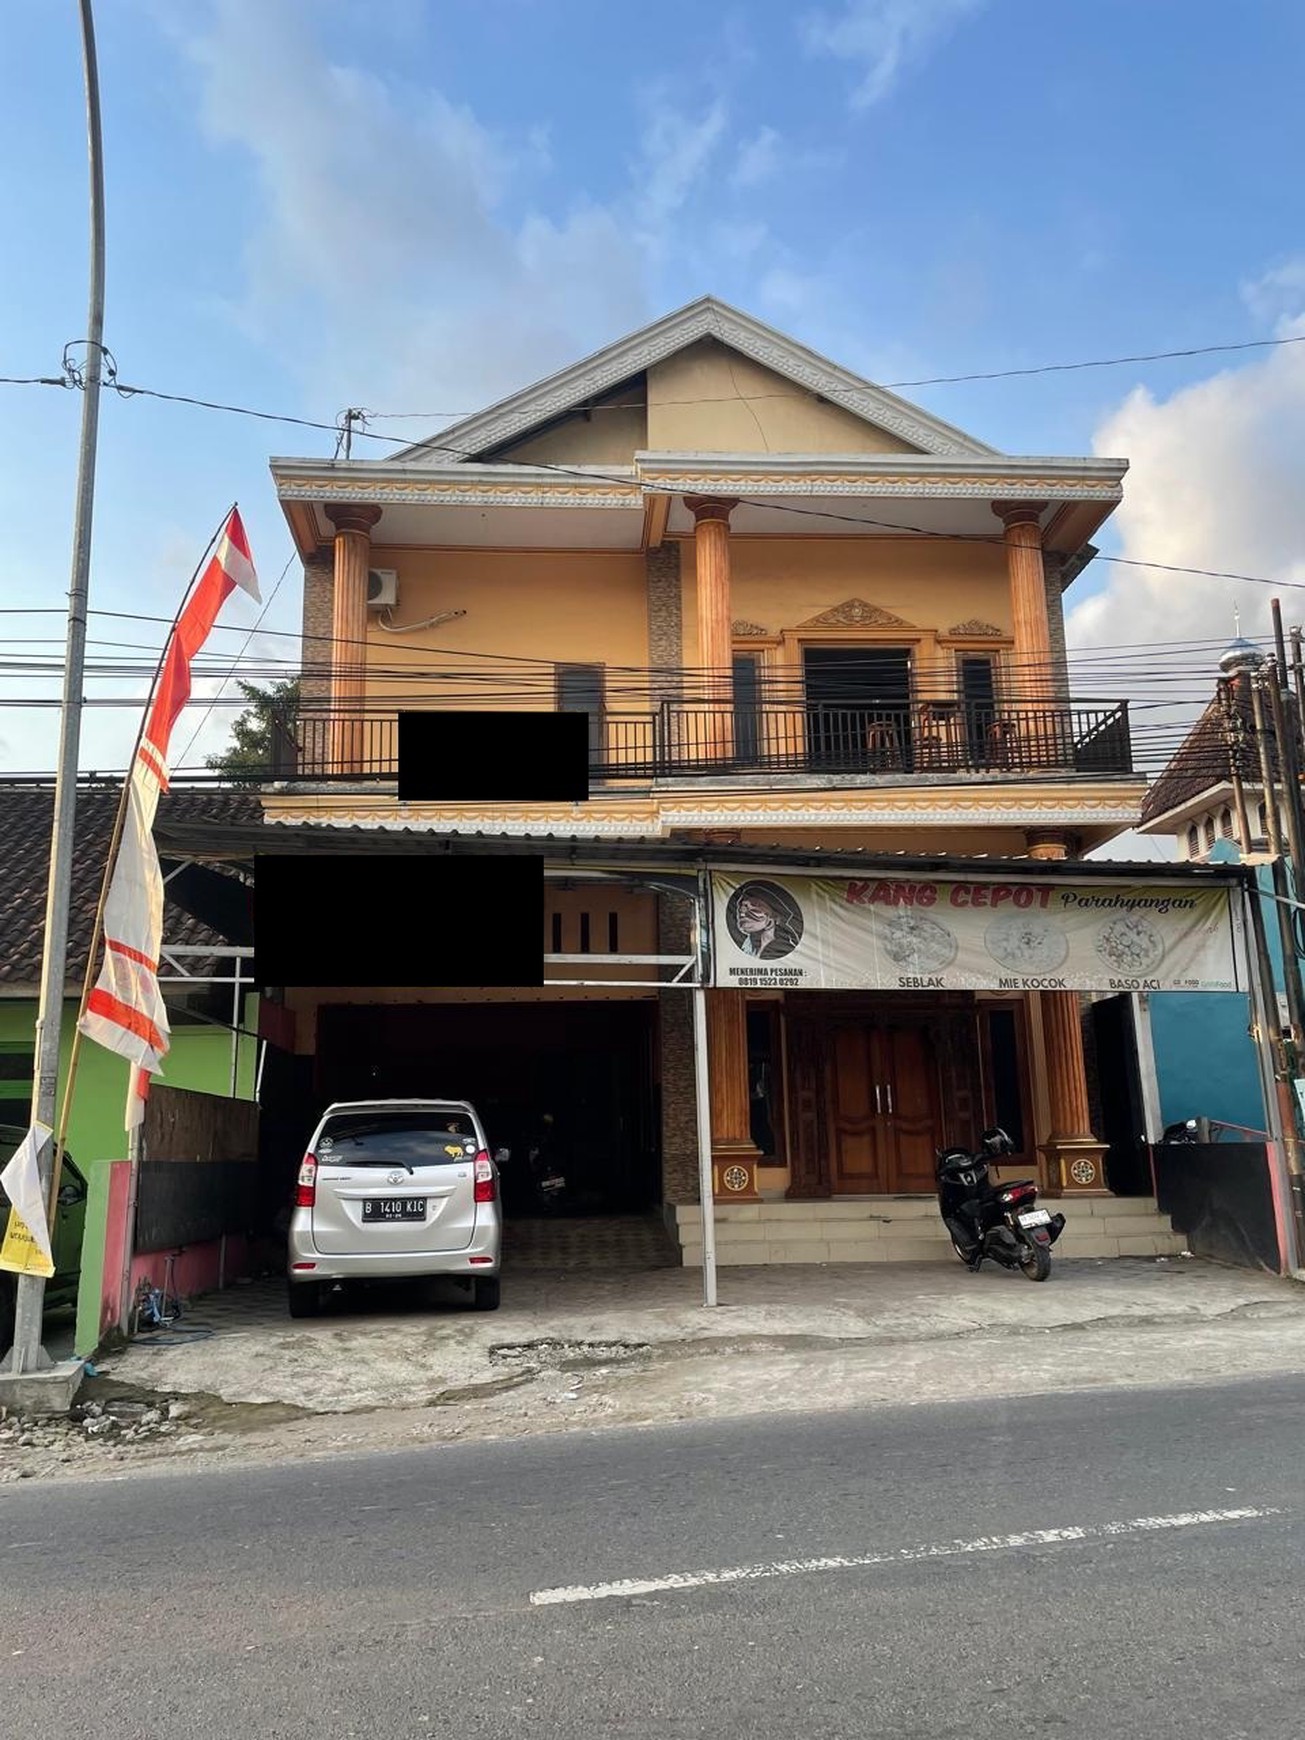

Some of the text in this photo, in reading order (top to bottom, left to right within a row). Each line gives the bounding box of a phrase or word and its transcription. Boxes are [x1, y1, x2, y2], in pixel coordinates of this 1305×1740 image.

[847, 881, 1056, 908] KANG CEPOT
[1061, 892, 1197, 914] Parahyangan
[729, 967, 769, 976] MENERIMA
[769, 967, 803, 976] PESANAN
[898, 976, 945, 988] SEBLAK
[999, 978, 1067, 989] MIE KOCOK
[1109, 979, 1161, 989] BASO ACI
[365, 1200, 424, 1213] B 1410 KIC
